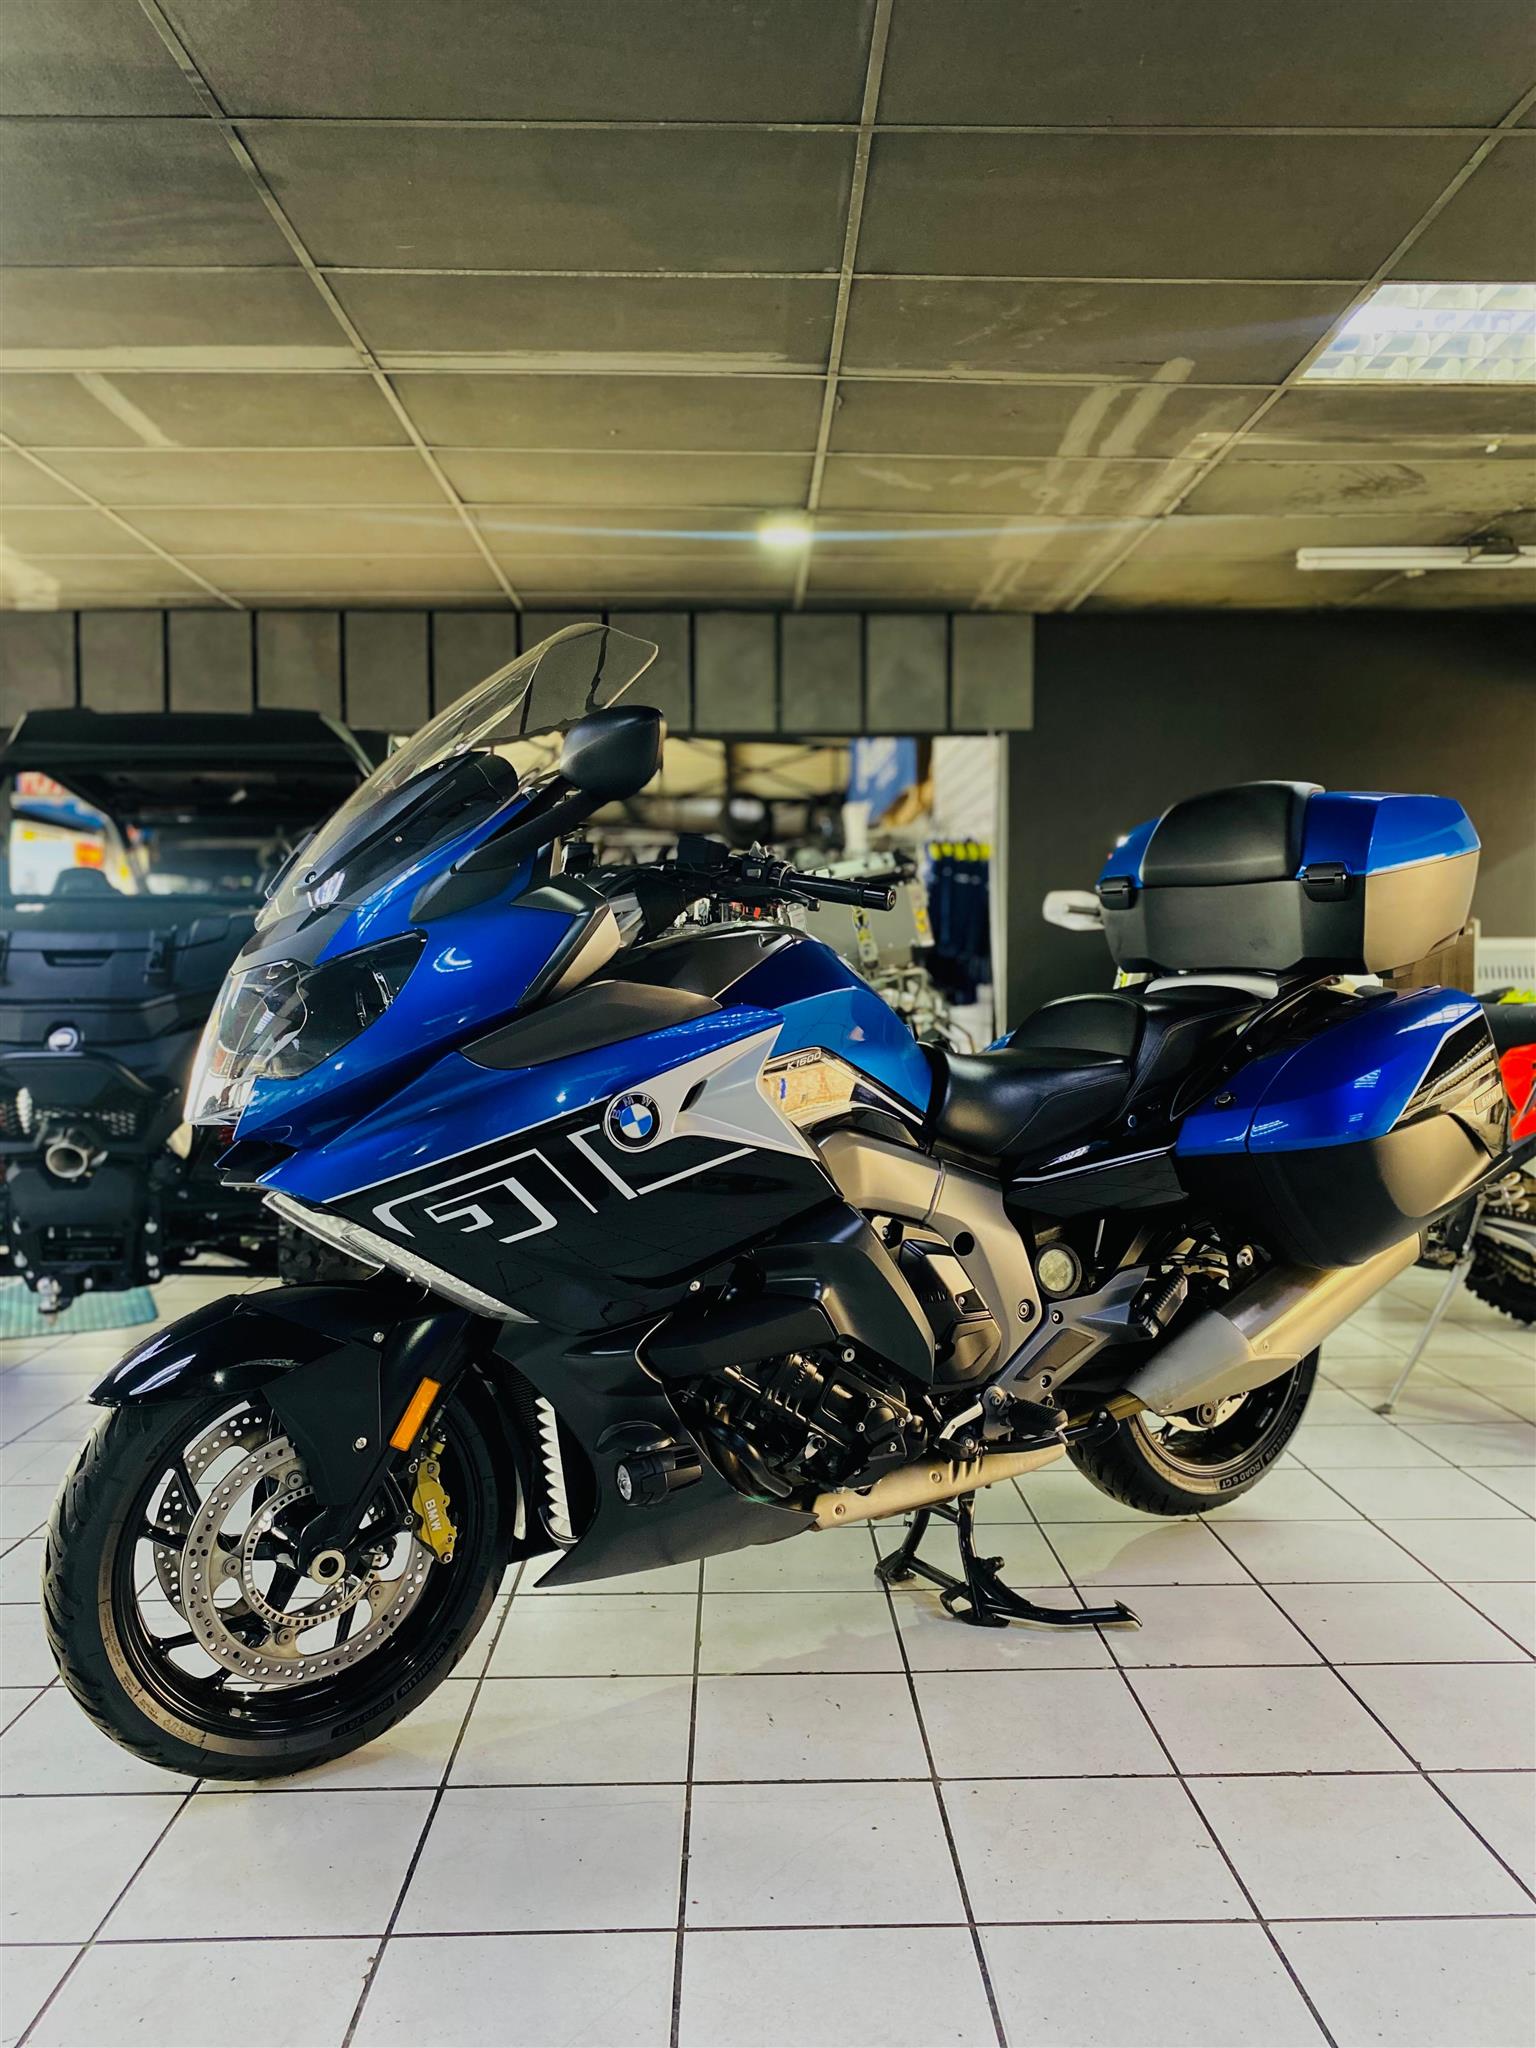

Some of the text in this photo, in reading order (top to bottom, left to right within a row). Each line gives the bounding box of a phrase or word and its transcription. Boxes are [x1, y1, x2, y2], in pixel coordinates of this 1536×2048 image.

[786, 1050, 822, 1071] K1600
[611, 1095, 652, 1120] BMW
[1220, 1461, 1263, 1489] ROAD 6 GT
[424, 1498, 442, 1531] BMW
